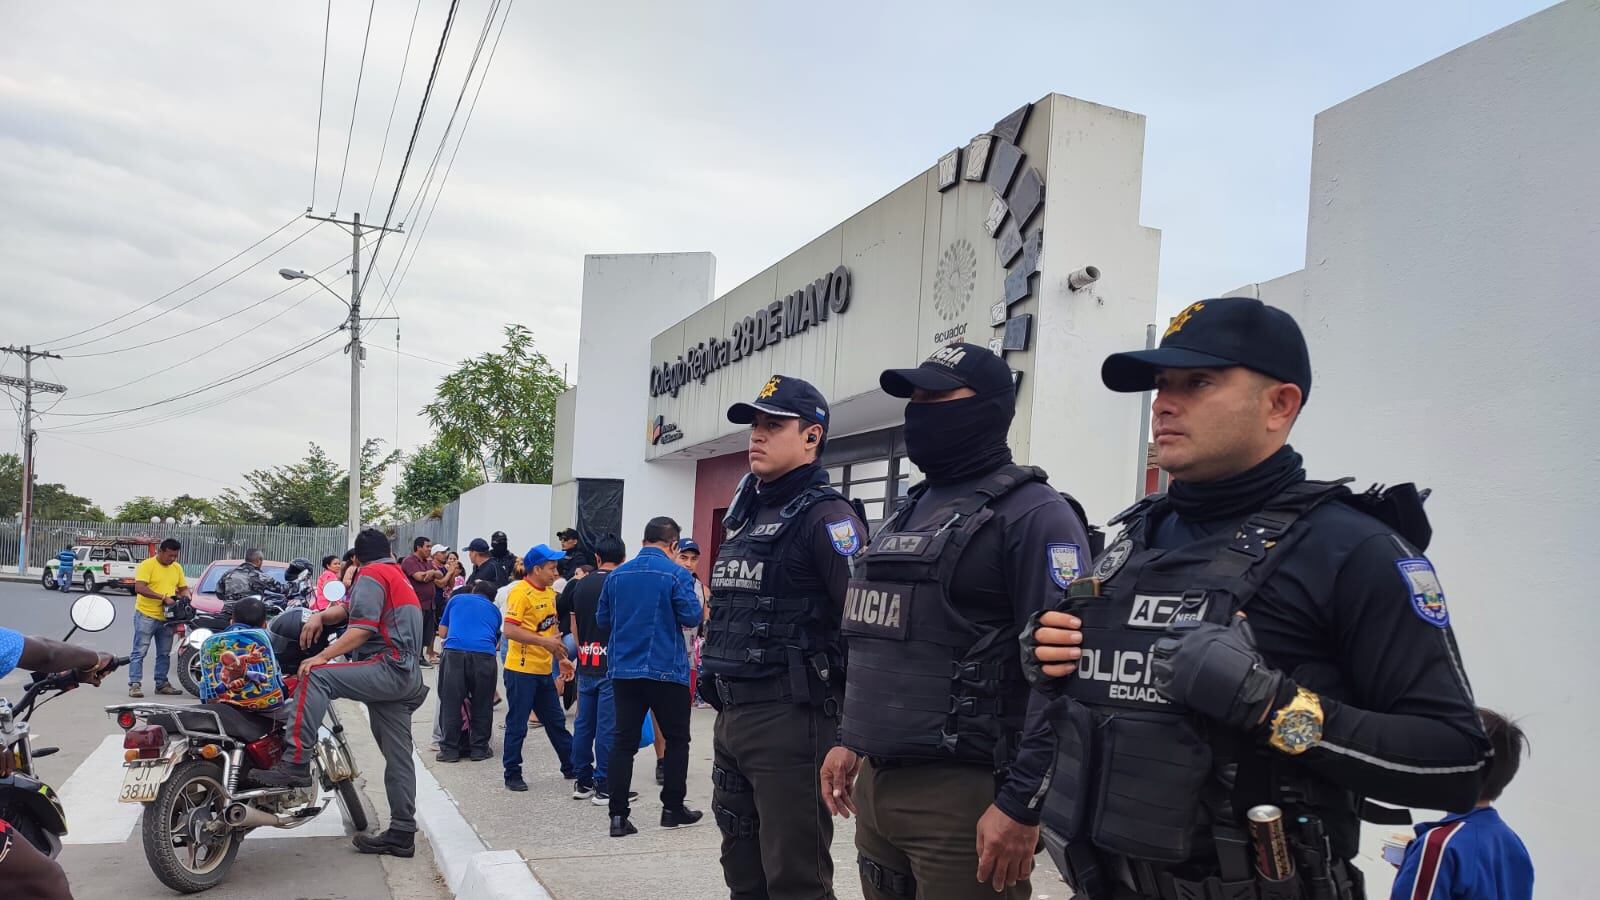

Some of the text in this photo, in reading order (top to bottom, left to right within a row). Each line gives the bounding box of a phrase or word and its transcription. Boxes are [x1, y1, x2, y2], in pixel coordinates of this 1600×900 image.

[650, 265, 852, 398] Colegio Réplica 28 DE MAYO
[934, 322, 968, 343] ecuador
[1109, 685, 1171, 704] ECUAD
[121, 784, 157, 799] 381N
